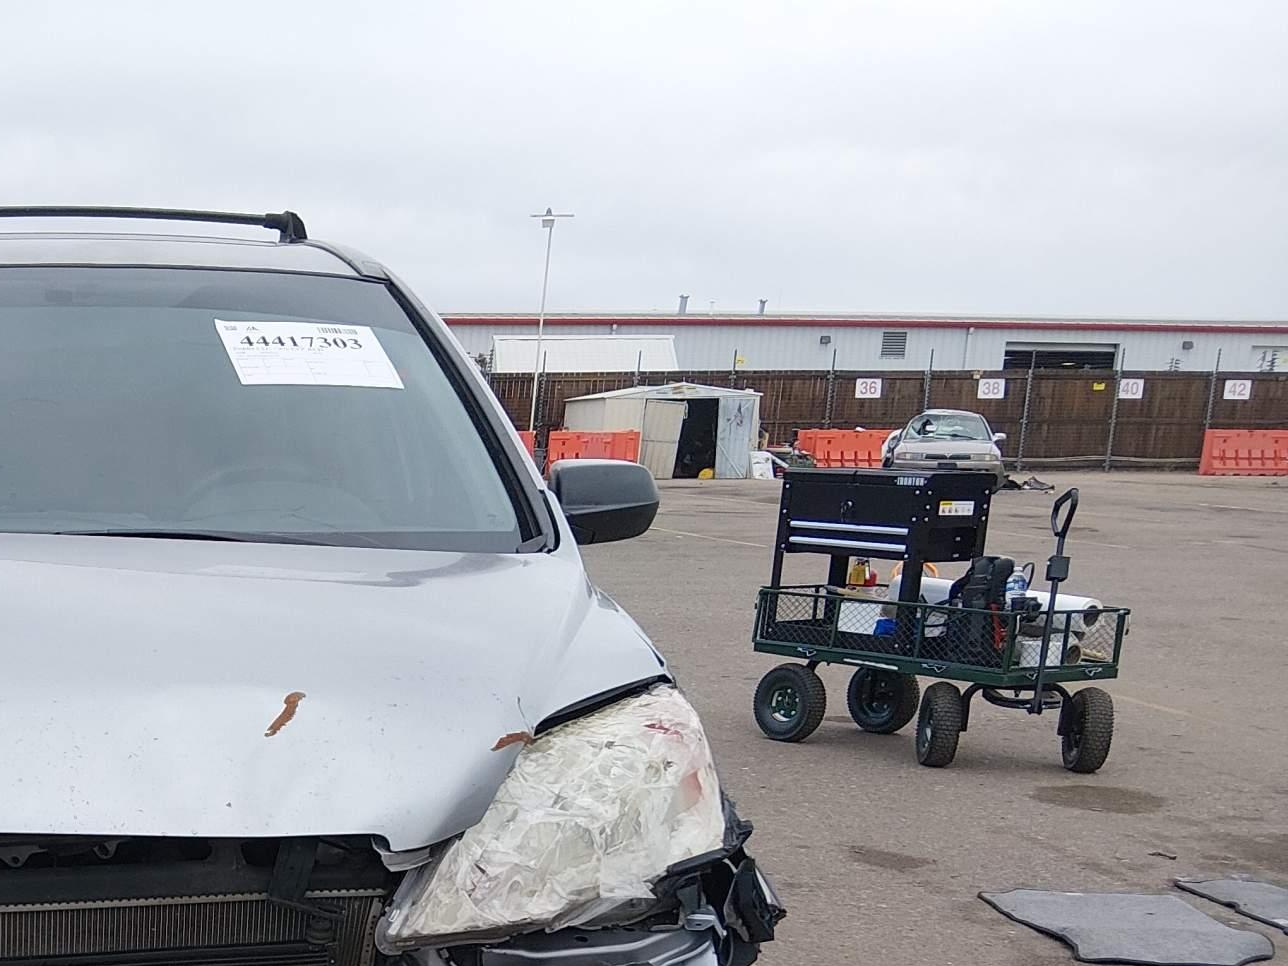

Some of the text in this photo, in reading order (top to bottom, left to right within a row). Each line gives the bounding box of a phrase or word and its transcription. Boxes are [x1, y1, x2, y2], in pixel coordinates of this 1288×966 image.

[239, 335, 363, 350] 44417303
[860, 381, 877, 394] 36
[983, 382, 1000, 394] 38
[1121, 382, 1139, 395] 40
[1229, 382, 1246, 396] 42
